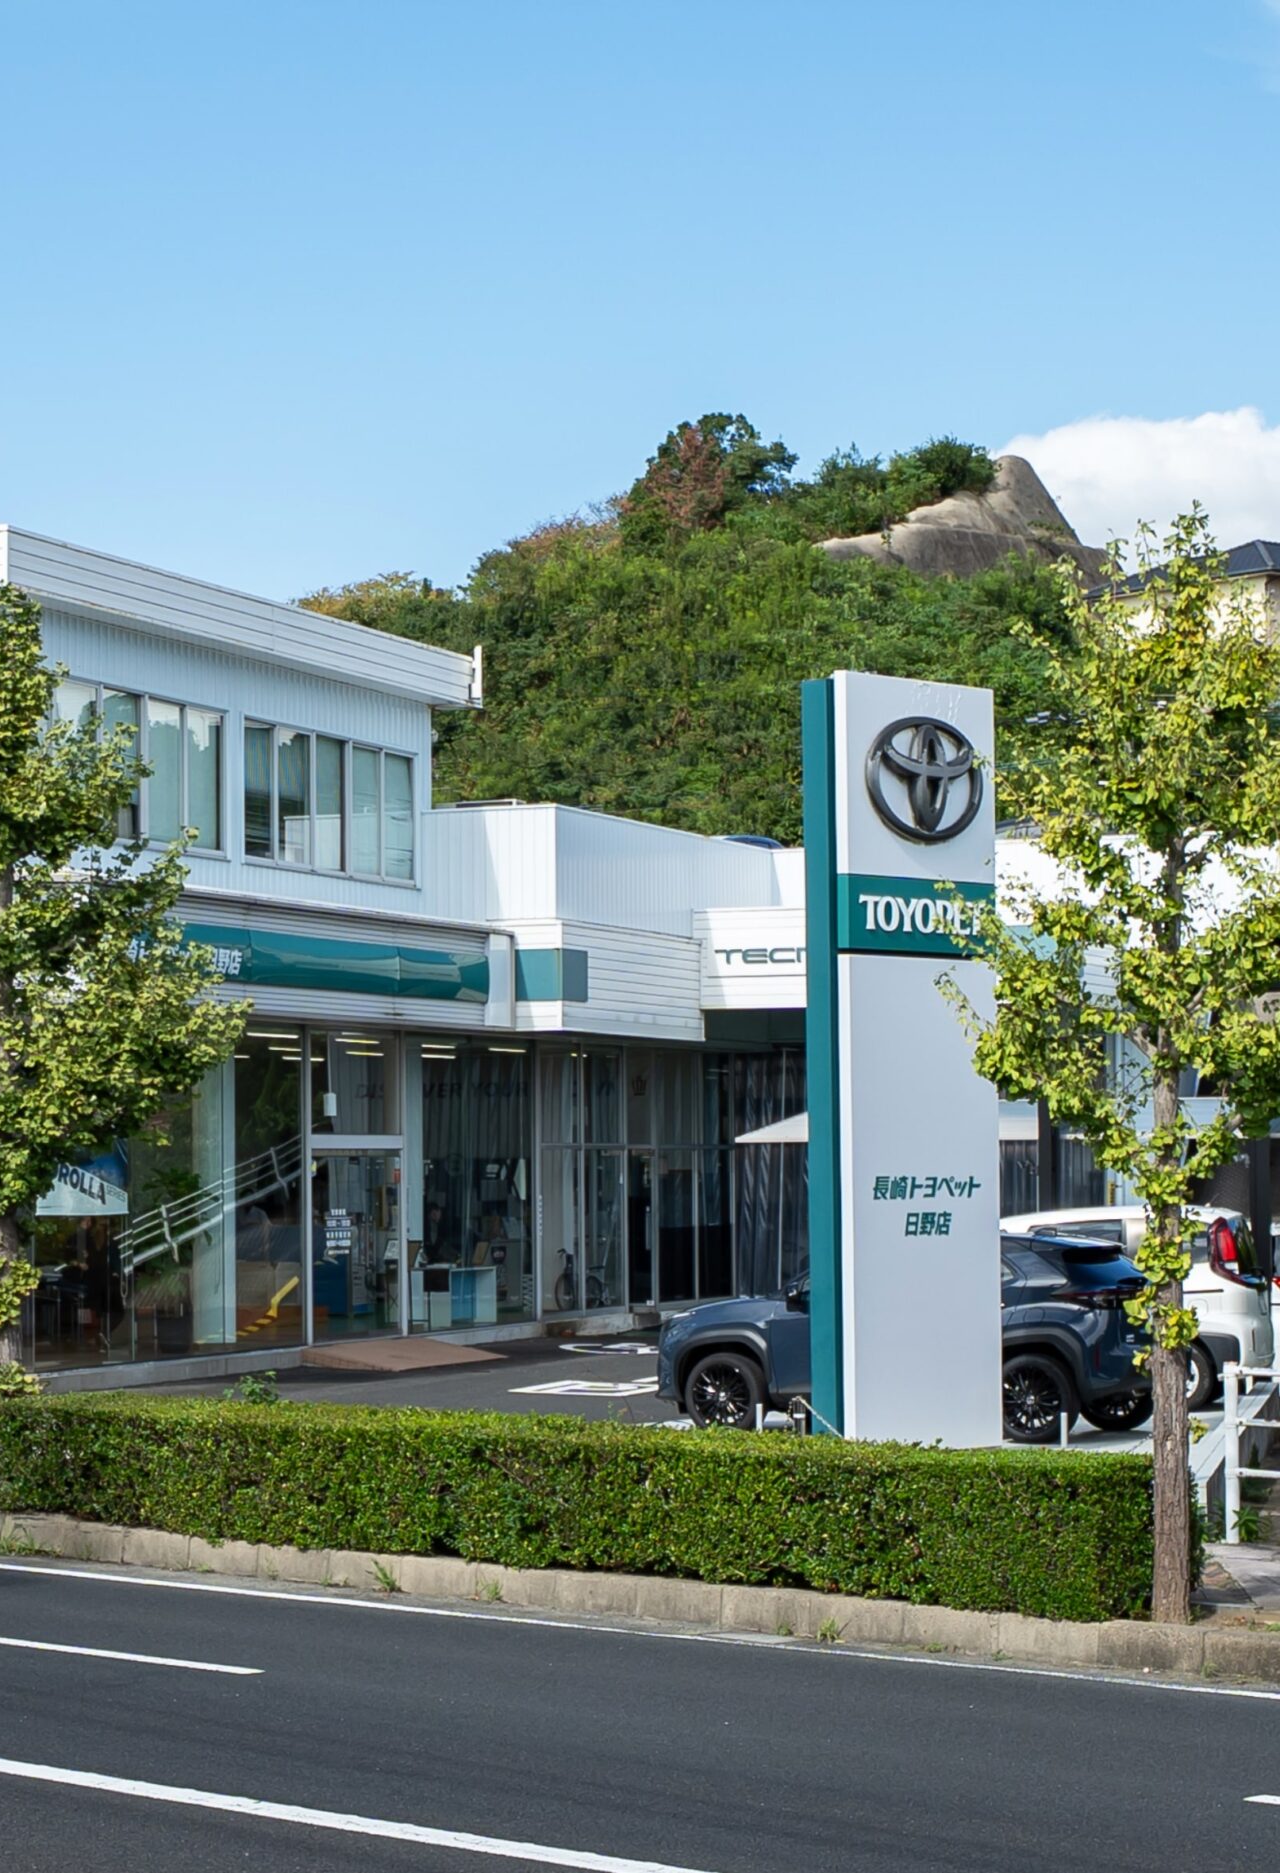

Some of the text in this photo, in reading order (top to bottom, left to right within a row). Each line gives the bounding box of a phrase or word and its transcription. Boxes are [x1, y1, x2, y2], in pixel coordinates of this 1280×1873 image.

[57, 1163, 107, 1206] ROLLA
[872, 1175, 982, 1201] 長崎トヨペット
[904, 1210, 952, 1237] 日野店
